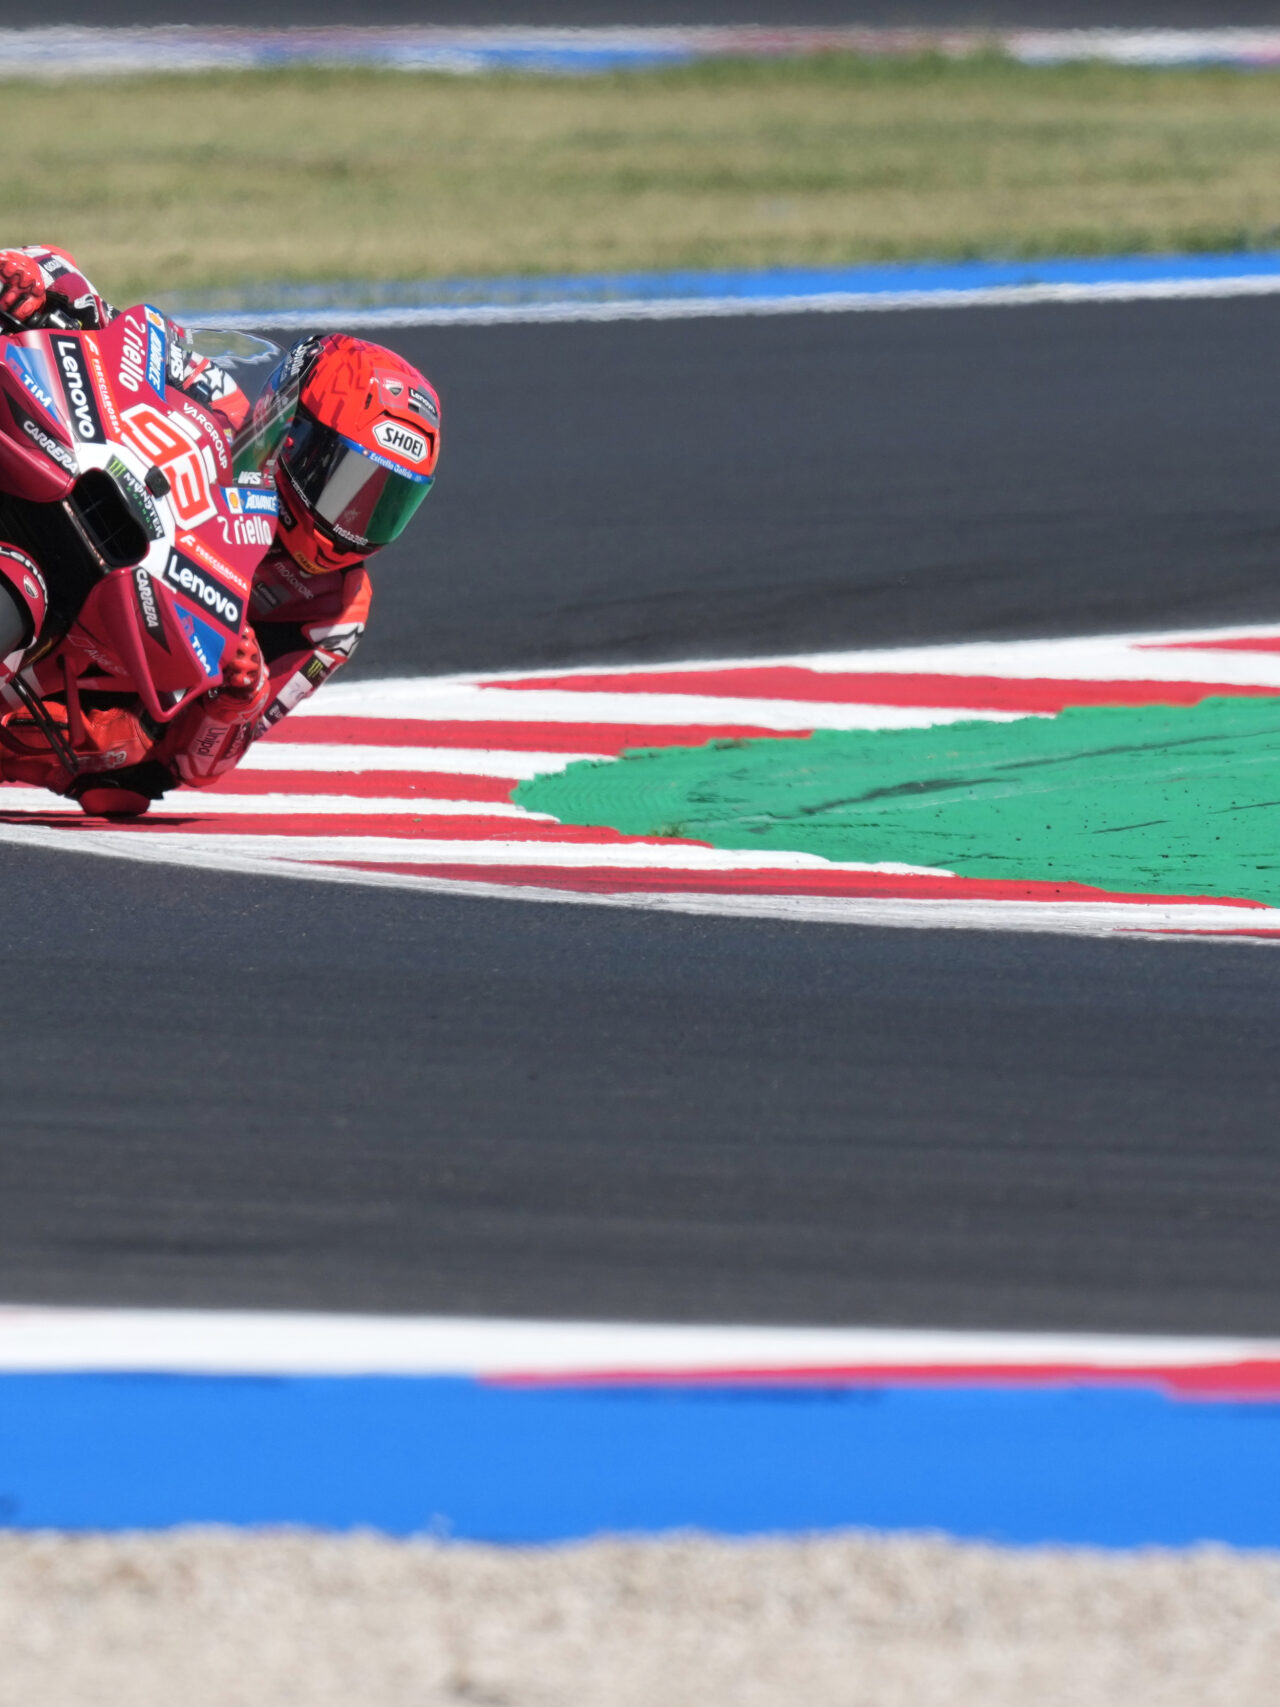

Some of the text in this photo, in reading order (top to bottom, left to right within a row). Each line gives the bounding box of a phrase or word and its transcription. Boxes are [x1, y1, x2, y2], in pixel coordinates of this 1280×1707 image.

[57, 340, 96, 439] Lenovo
[118, 331, 147, 392] riello
[23, 374, 51, 408] TIM
[92, 357, 121, 434] FRECCIAROSSA
[23, 419, 78, 475] CARRERA
[183, 402, 228, 470] VARGROUP
[369, 452, 394, 470] Estrella
[382, 427, 423, 457] SHOEI
[123, 471, 164, 538] MONSTER
[234, 516, 272, 545] riello
[168, 555, 239, 622] Lenovo
[195, 544, 248, 591] FRECCIAROSSA
[136, 568, 159, 628] CARRERA
[192, 635, 211, 674] TIM
[197, 726, 228, 758] Unipol
